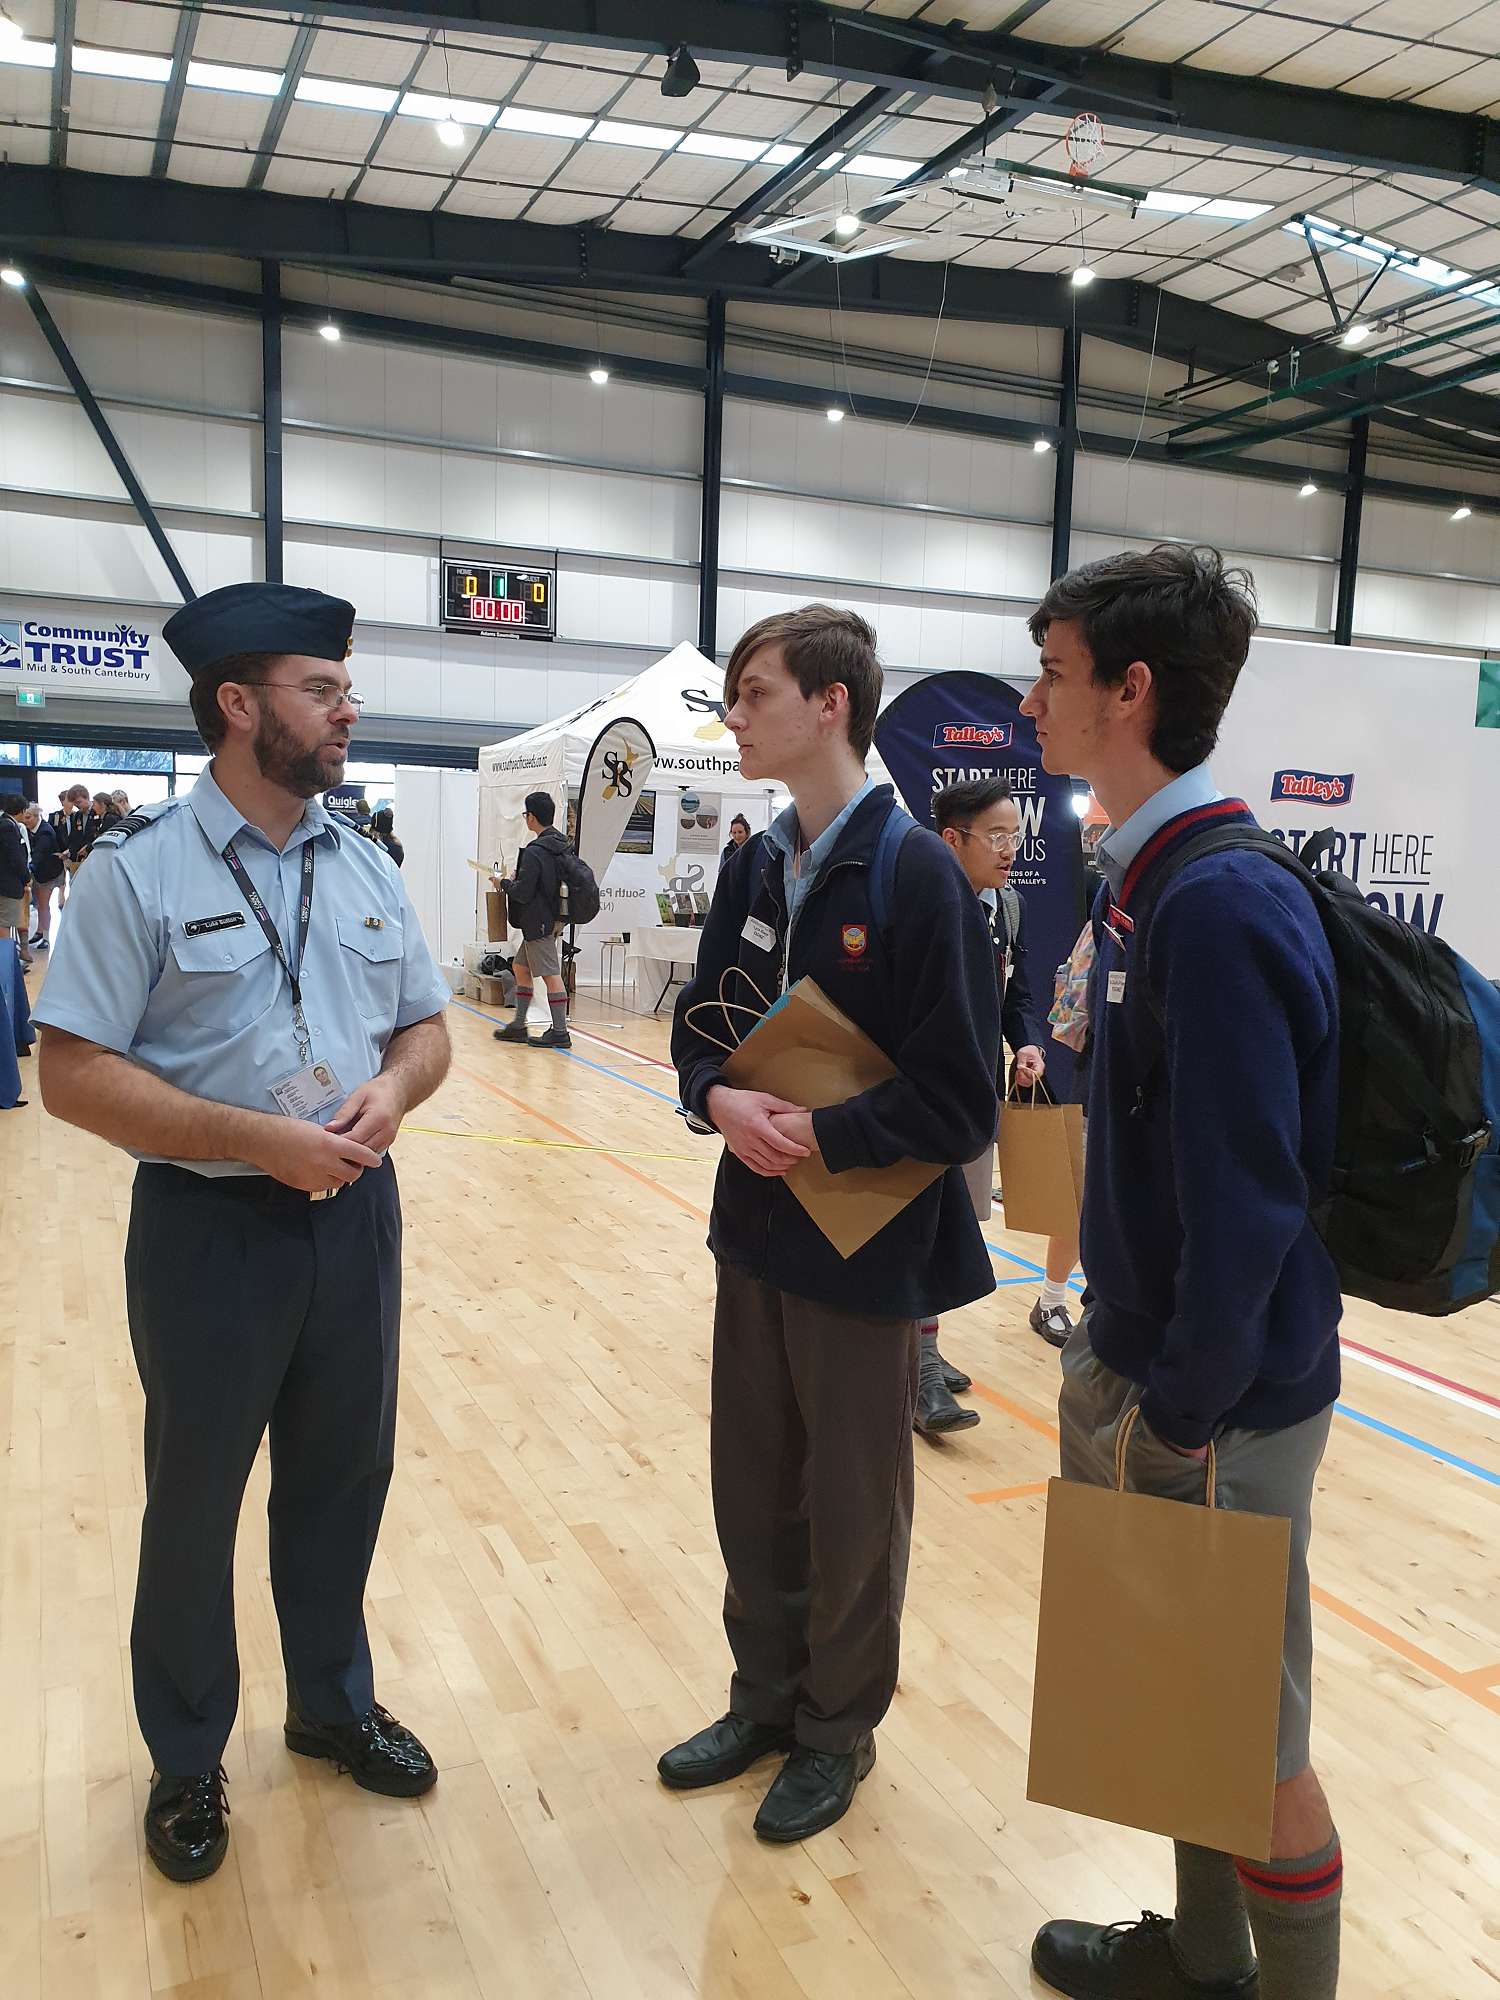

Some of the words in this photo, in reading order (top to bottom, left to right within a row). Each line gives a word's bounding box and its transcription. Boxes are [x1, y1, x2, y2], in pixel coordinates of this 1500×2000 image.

[466, 576, 477, 596] 0
[534, 583, 545, 603] 0
[24, 622, 150, 648] Community
[24, 641, 150, 669] TRUST
[27, 663, 47, 672] Mid
[50, 665, 58, 673] &
[62, 665, 91, 676] South
[94, 668, 151, 681] Canterbury
[943, 726, 1004, 745] Talley's
[1281, 775, 1345, 800] Talley's
[1023, 839, 1046, 861] US
[1371, 833, 1434, 875] HERE
